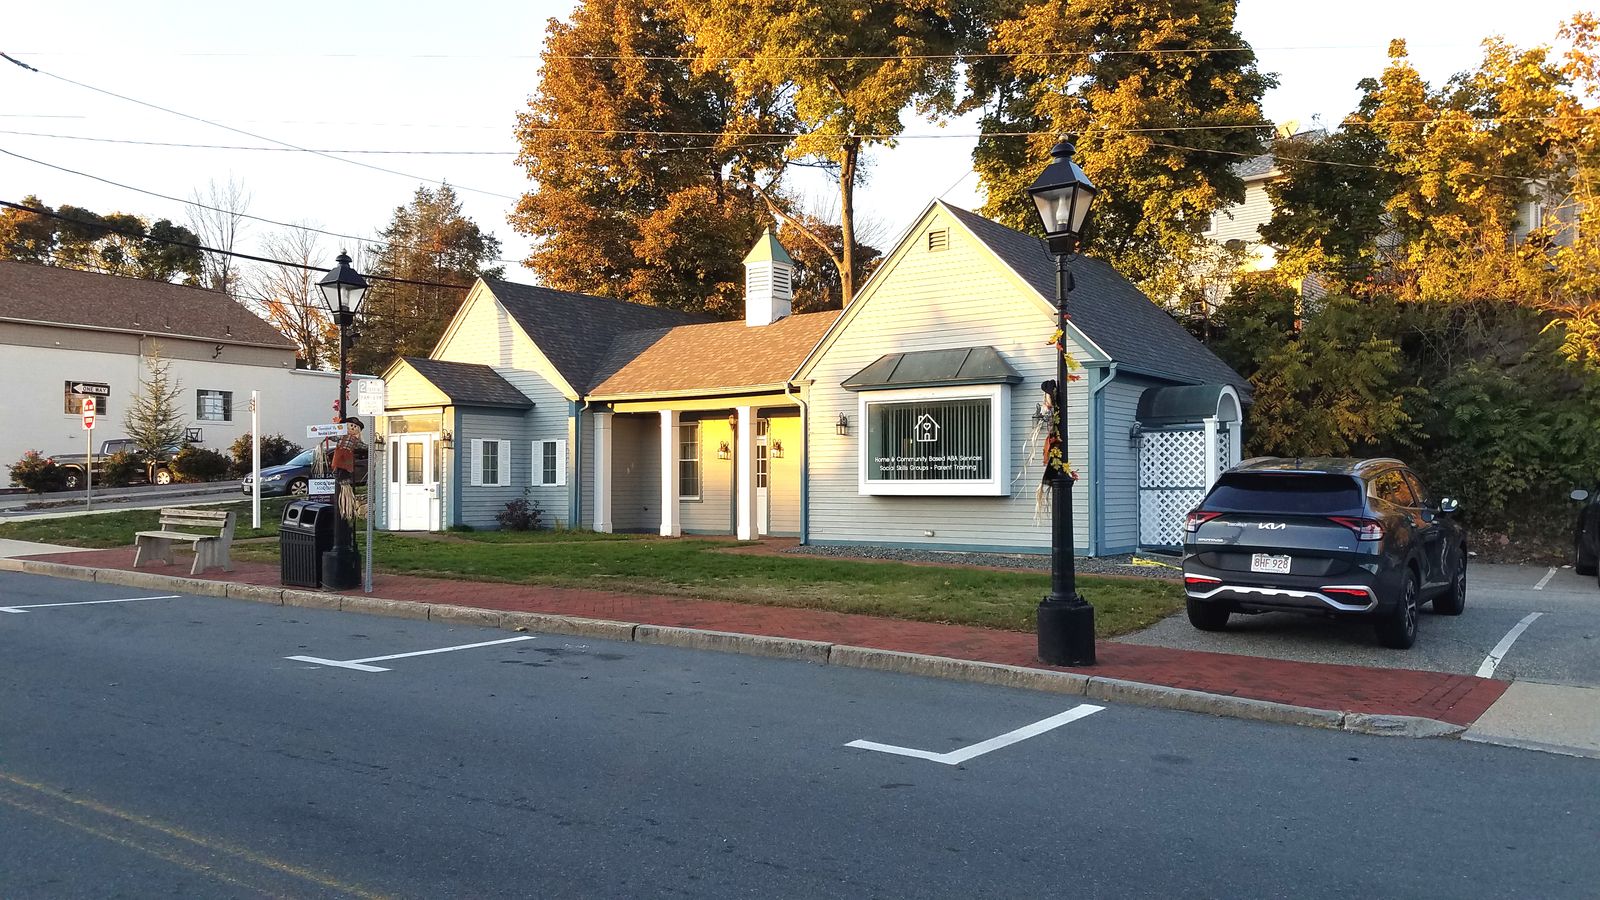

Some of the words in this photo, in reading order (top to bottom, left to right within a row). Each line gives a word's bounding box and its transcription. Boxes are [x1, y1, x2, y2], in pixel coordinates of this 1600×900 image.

[360, 381, 366, 392] 2
[1255, 558, 1270, 567] 8HF
[1272, 560, 1288, 568] 928
